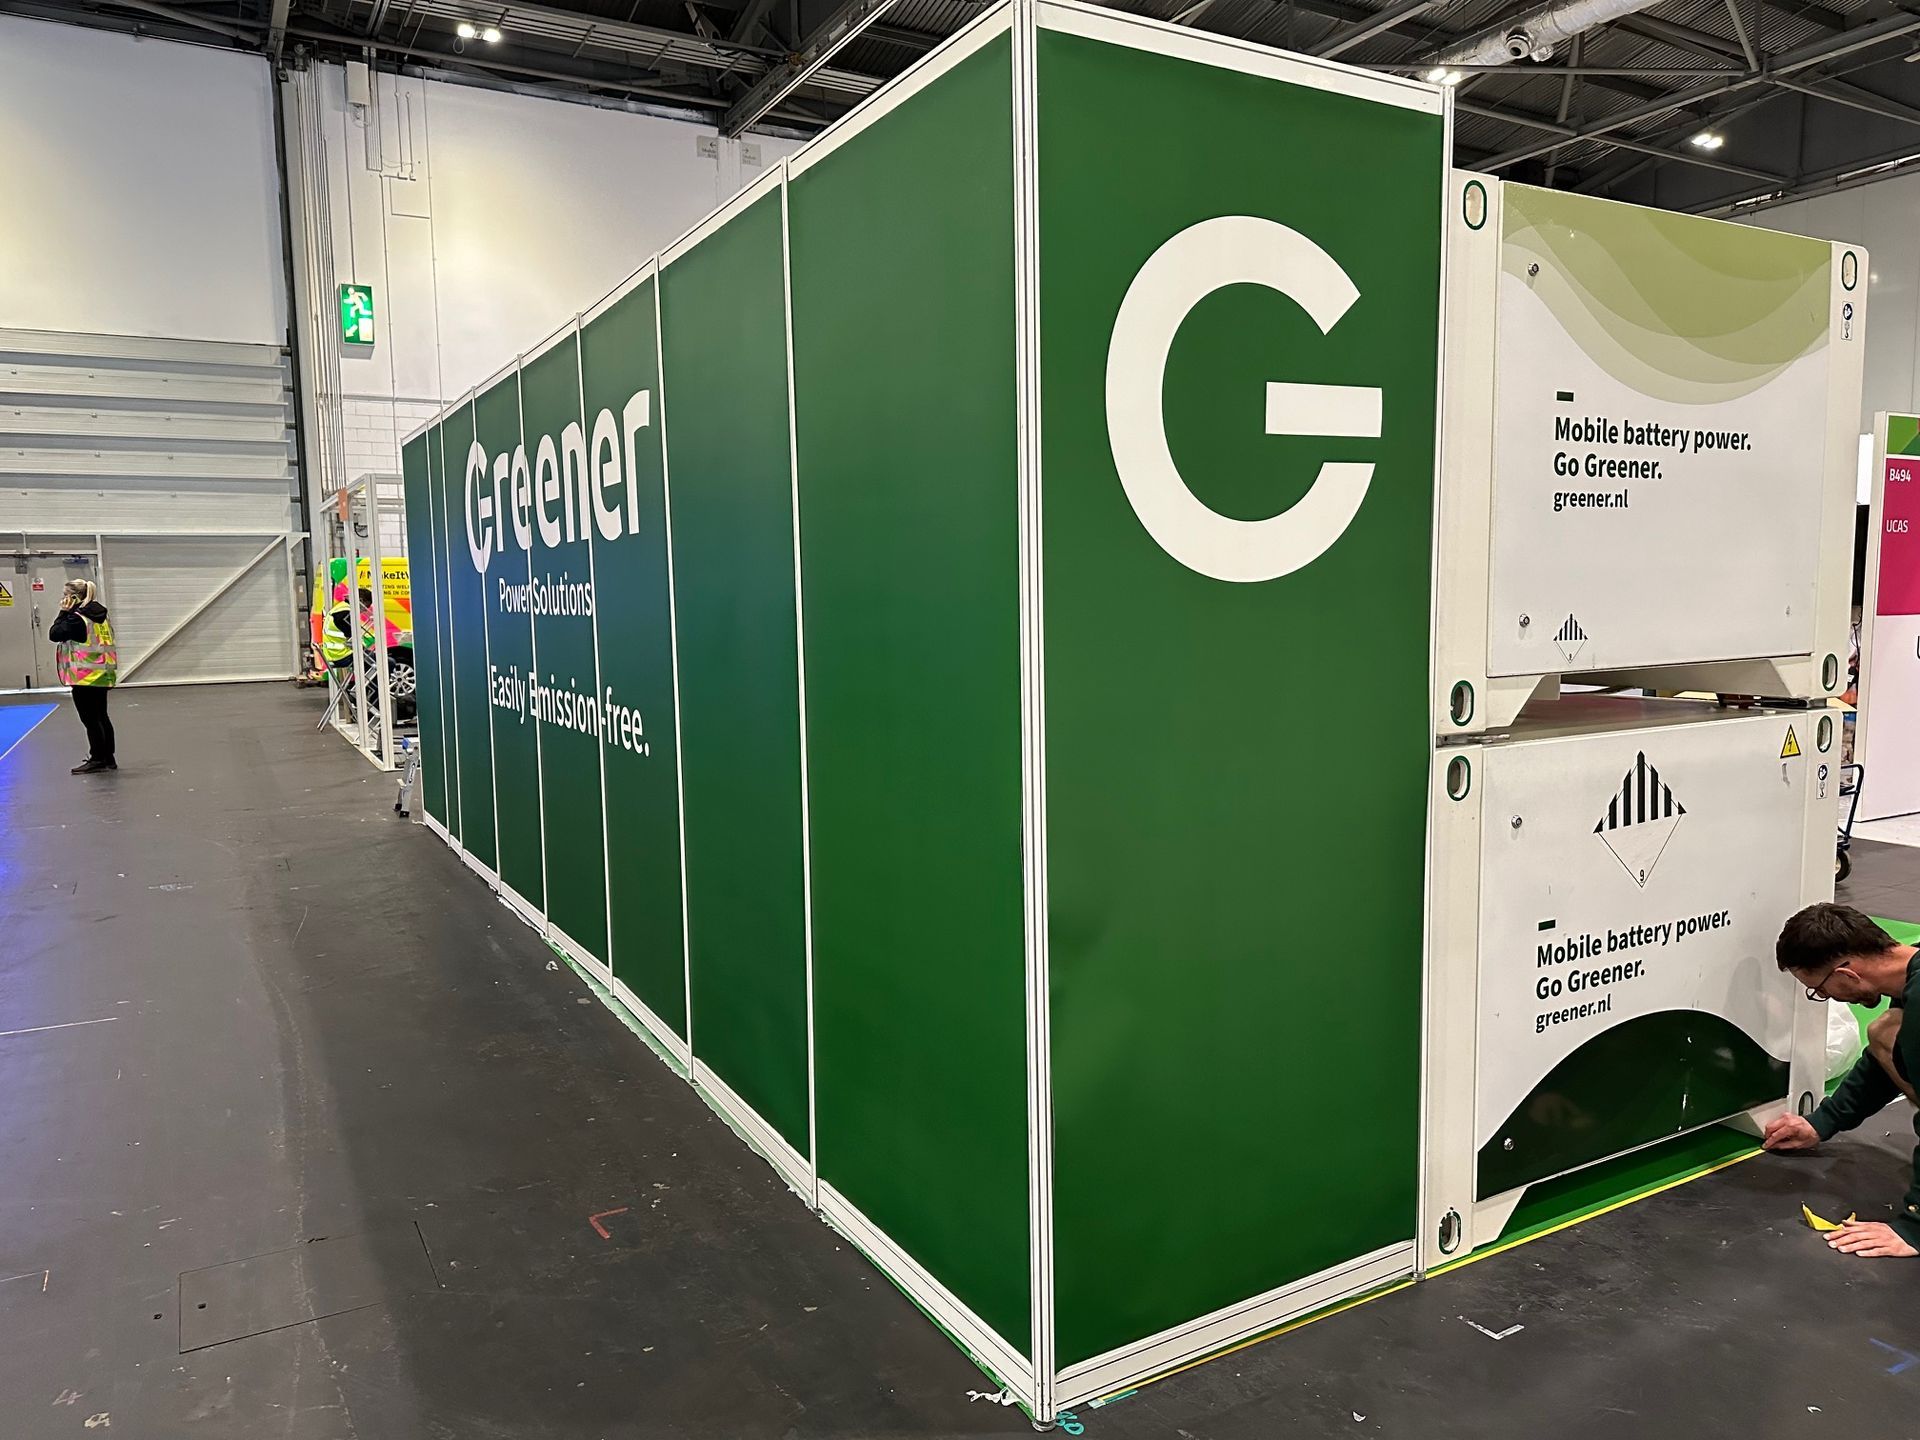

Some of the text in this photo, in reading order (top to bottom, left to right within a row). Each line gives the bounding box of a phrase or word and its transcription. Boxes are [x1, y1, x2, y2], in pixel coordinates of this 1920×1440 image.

[1555, 416, 1752, 454] Mobile battery power.
[465, 389, 650, 574] Greener
[1553, 451, 1663, 480] Go Greener.
[1889, 468, 1911, 482] B494
[1553, 488, 1629, 512] greener.nl
[1886, 519, 1908, 533] UCAS
[499, 571, 593, 617] Power Solutions
[490, 664, 526, 724] Easily
[1639, 869, 1645, 882] 9
[1536, 909, 1731, 968] Mobile battery power.
[1536, 959, 1645, 1000] Go Greener.
[1535, 993, 1611, 1034] greener.nl
